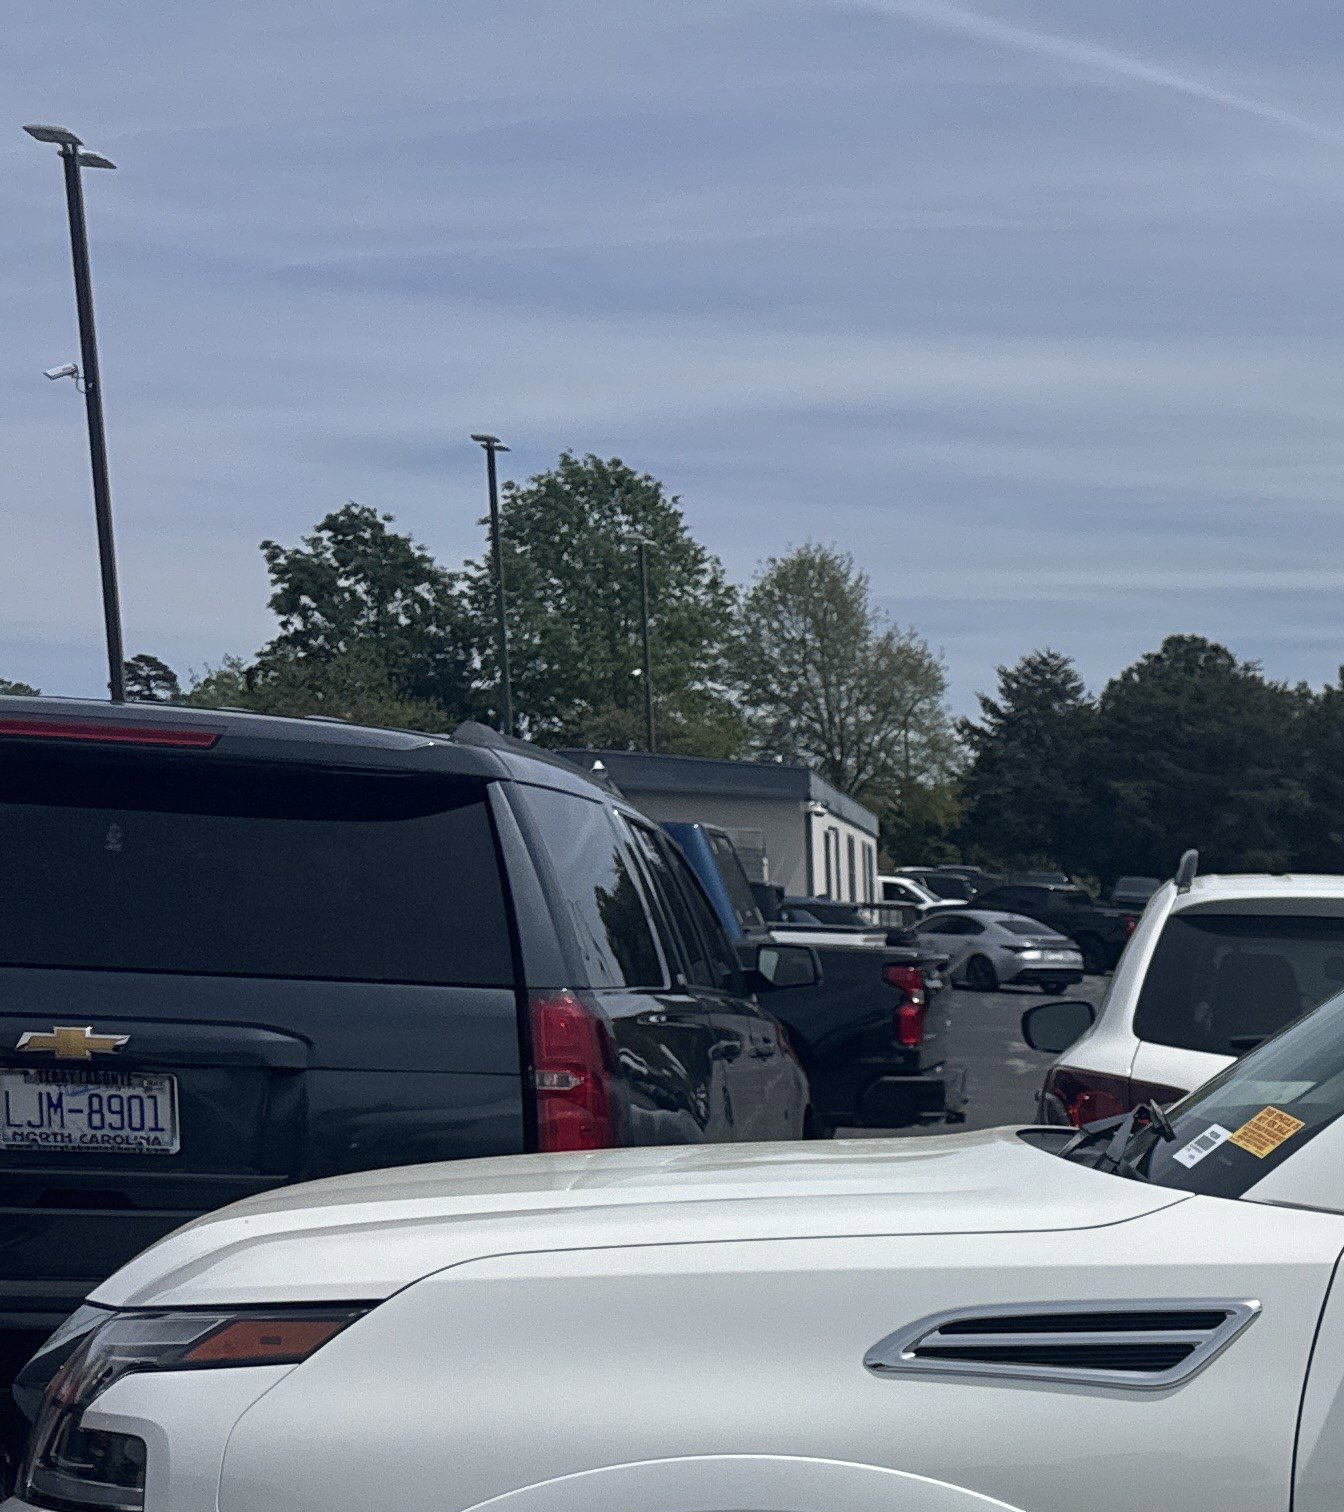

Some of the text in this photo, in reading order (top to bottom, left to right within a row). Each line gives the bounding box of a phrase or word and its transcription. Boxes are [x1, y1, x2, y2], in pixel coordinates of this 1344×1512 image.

[5, 1090, 165, 1132] LJM-8901
[12, 1131, 162, 1146] NORTH CAROLINA
